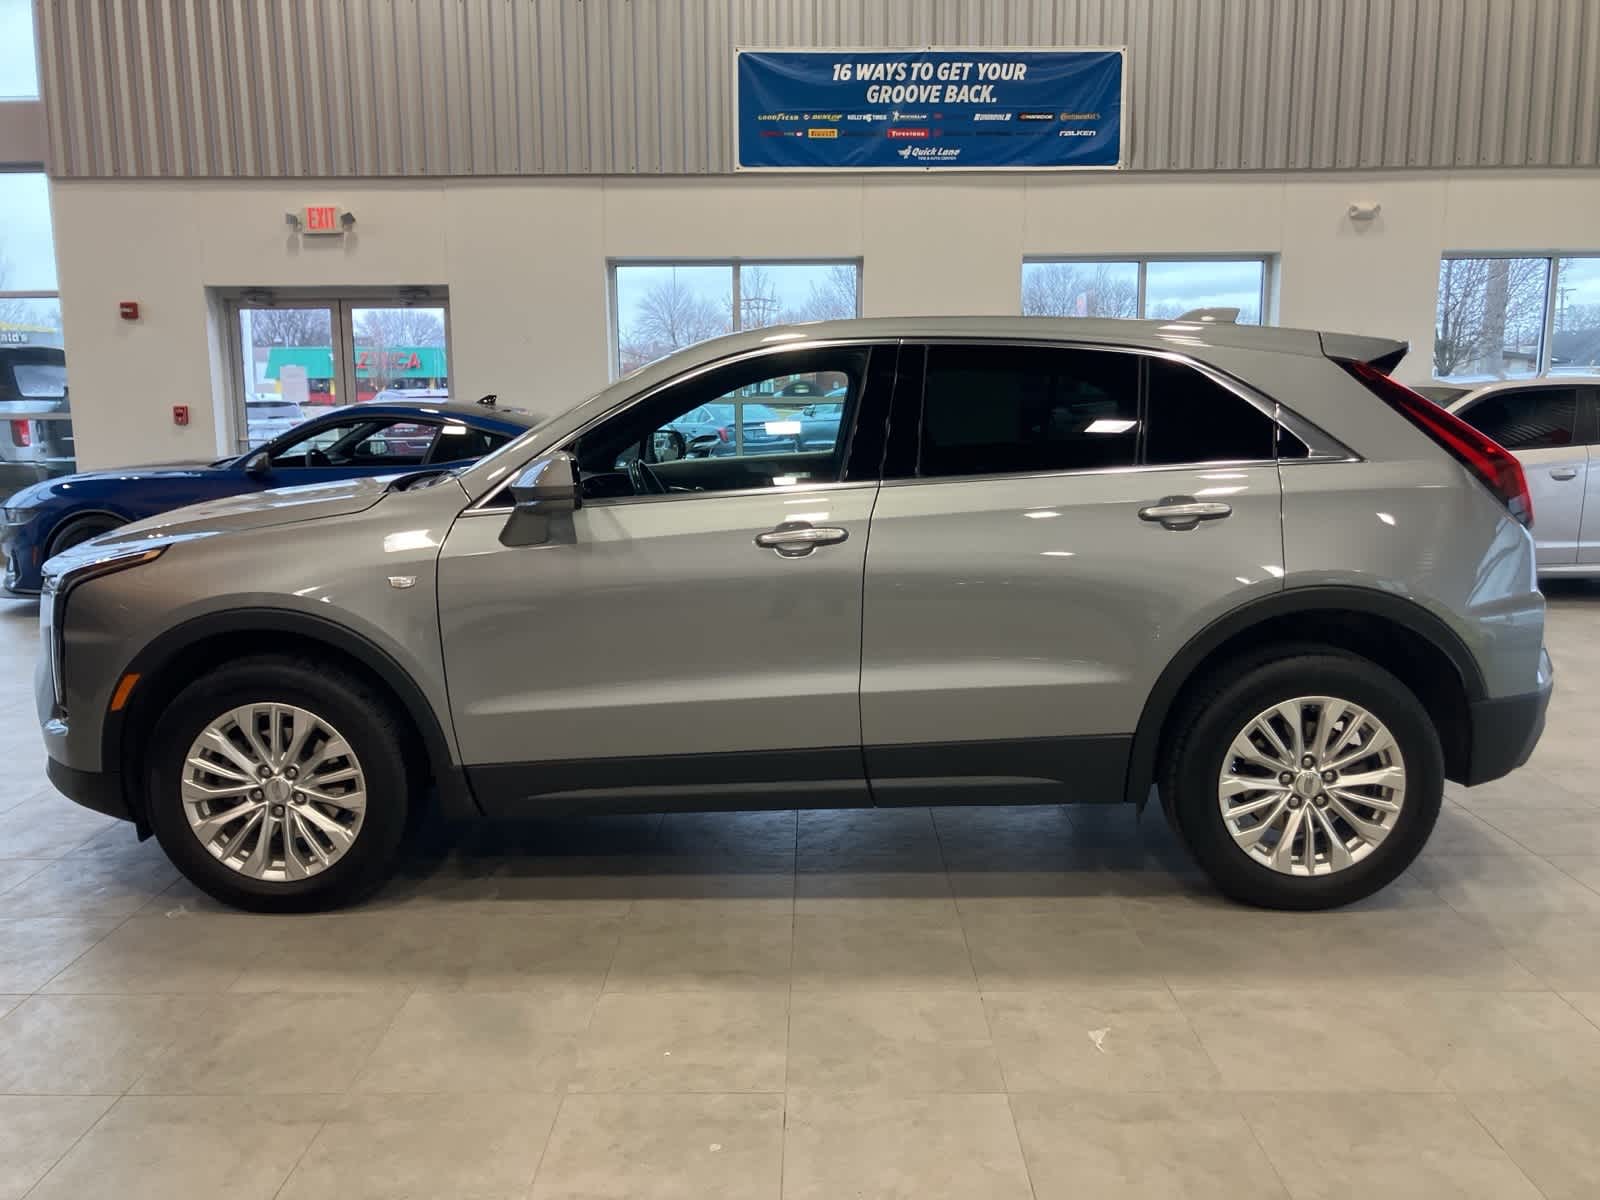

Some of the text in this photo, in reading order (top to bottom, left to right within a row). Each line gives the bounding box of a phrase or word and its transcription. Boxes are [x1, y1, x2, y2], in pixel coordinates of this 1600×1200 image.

[832, 62, 1027, 81] 16 WAYS TO GET YOUR
[866, 84, 997, 103] GROOVE BACK.
[911, 147, 937, 157] Quick
[306, 206, 336, 229] EXIT
